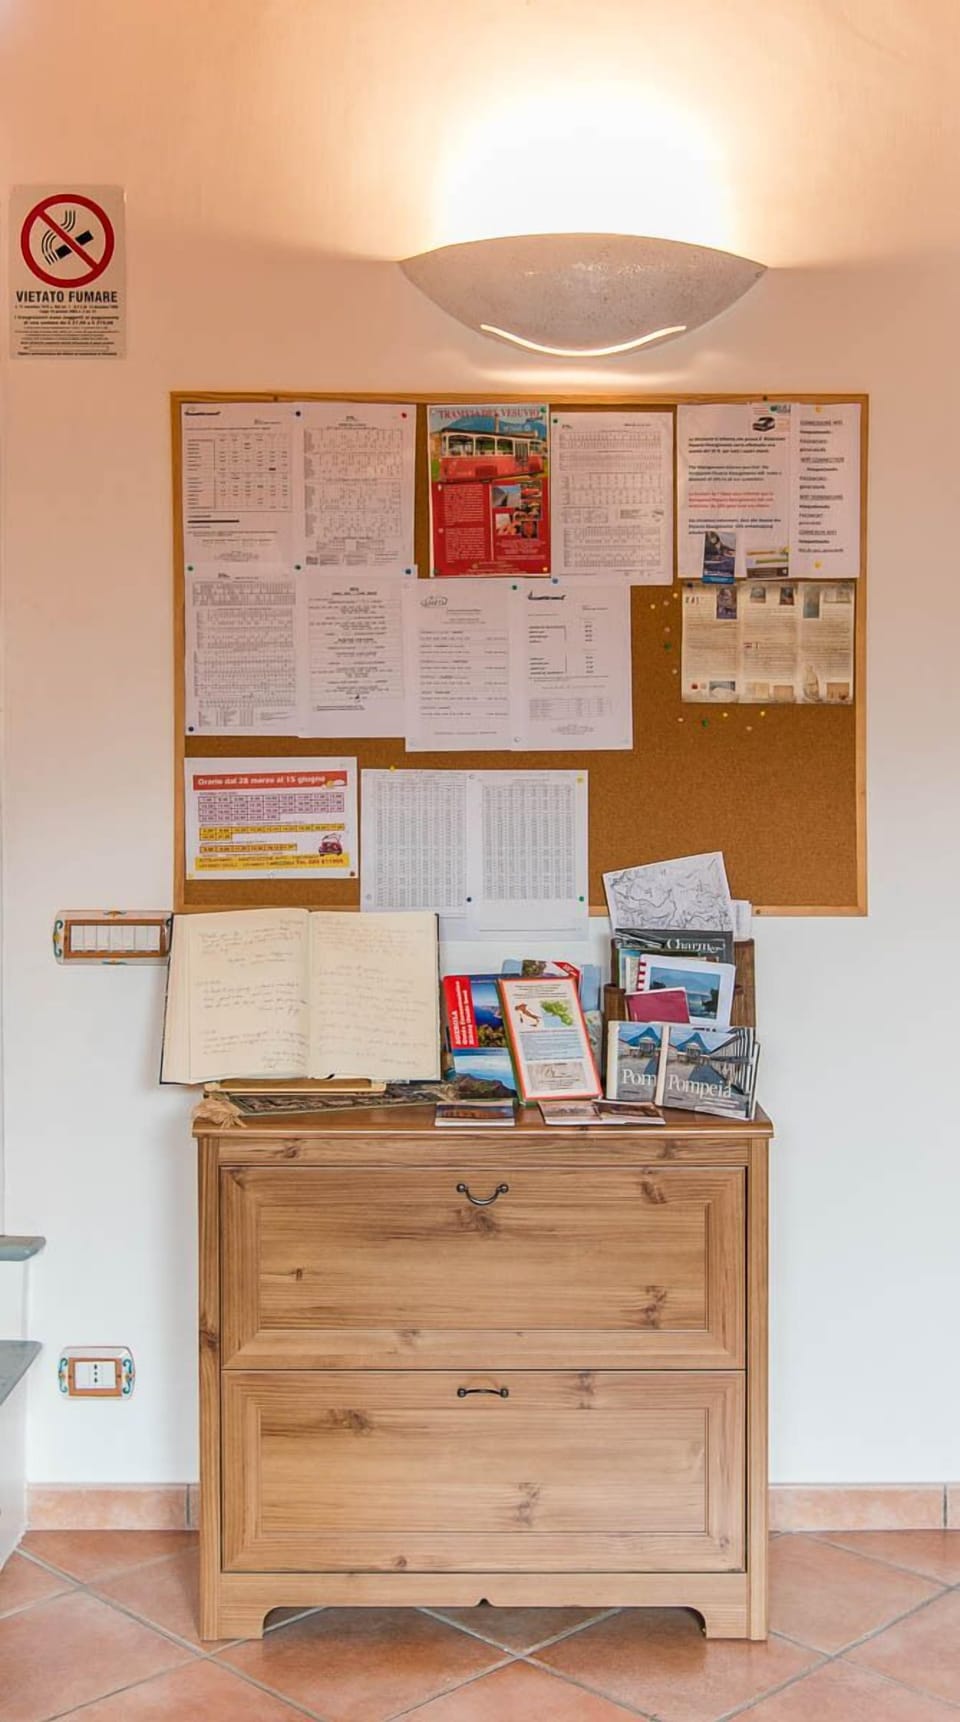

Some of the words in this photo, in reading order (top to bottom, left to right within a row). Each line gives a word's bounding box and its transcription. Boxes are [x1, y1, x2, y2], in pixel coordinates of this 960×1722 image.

[16, 290, 64, 303] VIETATO
[68, 290, 118, 303] FUMARE
[198, 778, 223, 786] Orario
[224, 777, 237, 785] dal
[238, 777, 249, 785] 28
[297, 775, 326, 784] giugno
